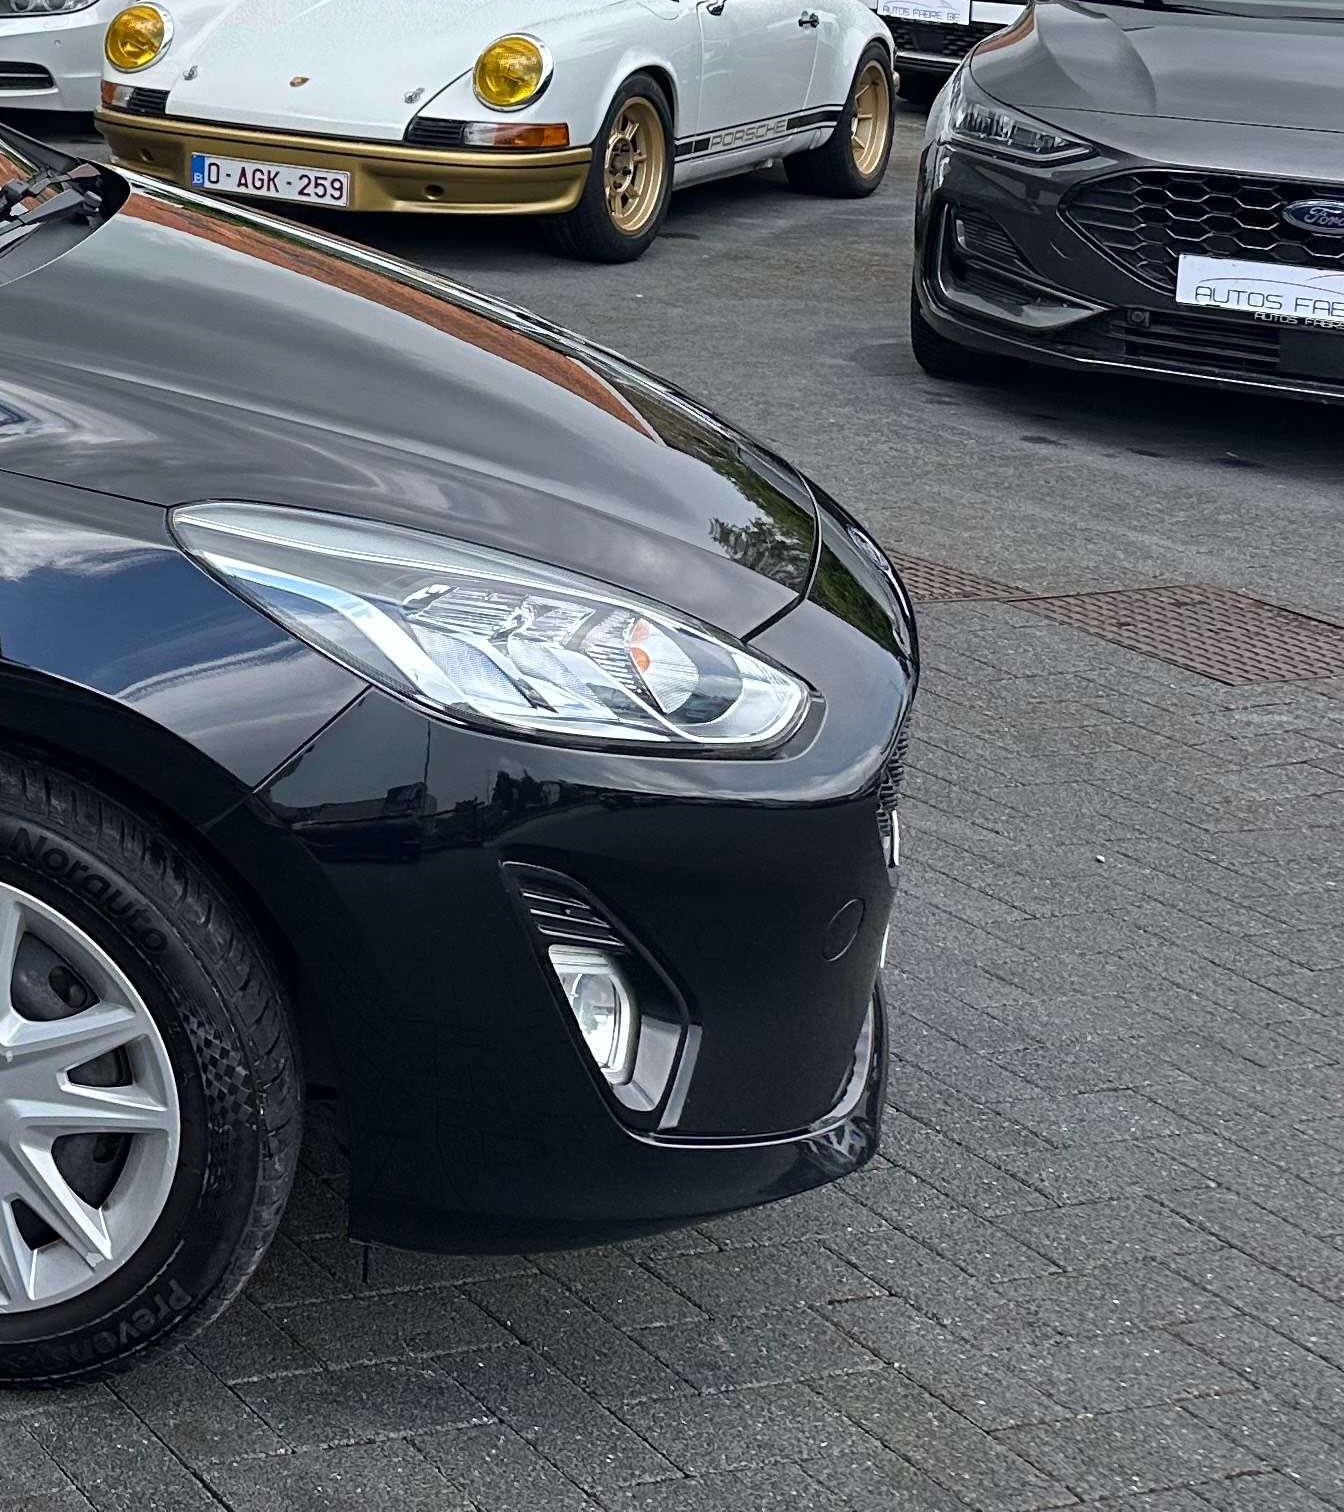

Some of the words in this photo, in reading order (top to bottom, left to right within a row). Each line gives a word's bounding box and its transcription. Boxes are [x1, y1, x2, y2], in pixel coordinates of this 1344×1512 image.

[711, 118, 787, 149] PORSCHE
[1194, 285, 1284, 311] AUTOS
[1254, 312, 1298, 325] AUTOS
[14, 827, 167, 951] Norauto
